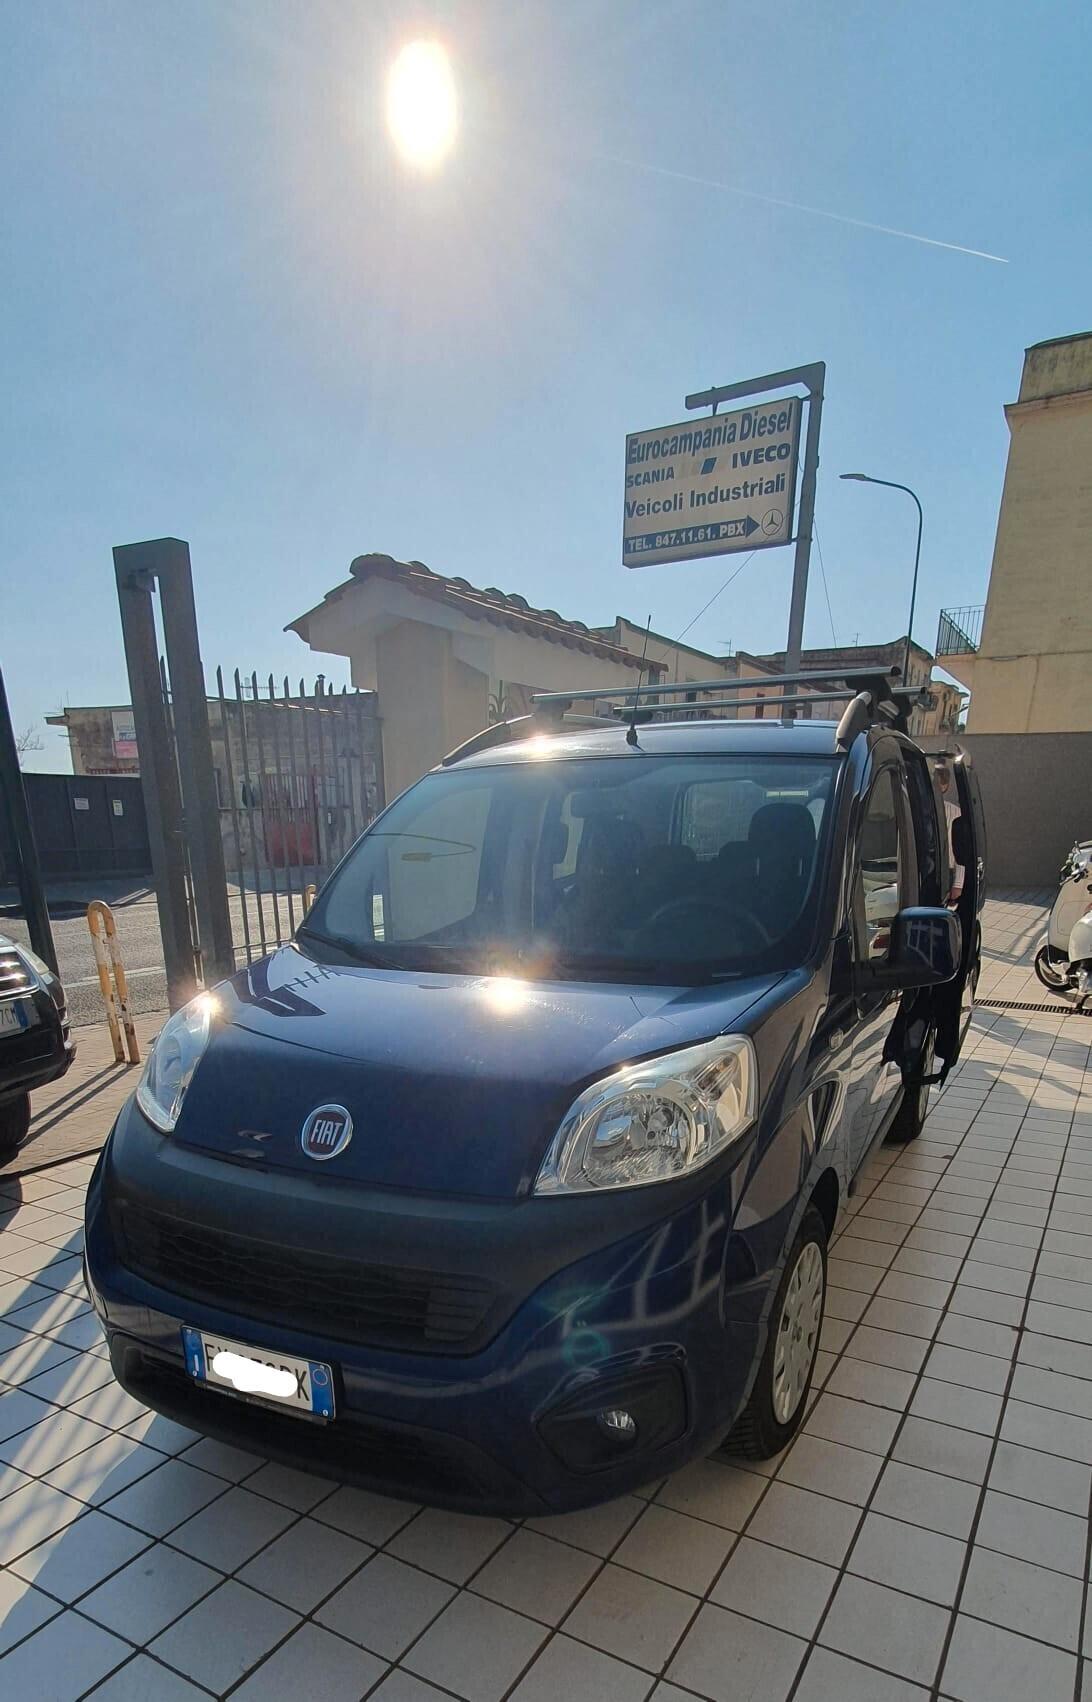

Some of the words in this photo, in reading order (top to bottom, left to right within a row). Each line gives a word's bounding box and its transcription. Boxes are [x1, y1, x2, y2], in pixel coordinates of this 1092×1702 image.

[628, 418, 736, 464] Eurocampania
[740, 403, 792, 441] Diesel
[732, 443, 791, 468] IVECO
[626, 467, 675, 488] SCANIA
[625, 493, 683, 518] Veicoli
[690, 473, 785, 507] Industriali
[628, 538, 652, 552] TEL.
[719, 523, 745, 537] PBX
[311, 1120, 343, 1146] FIAT
